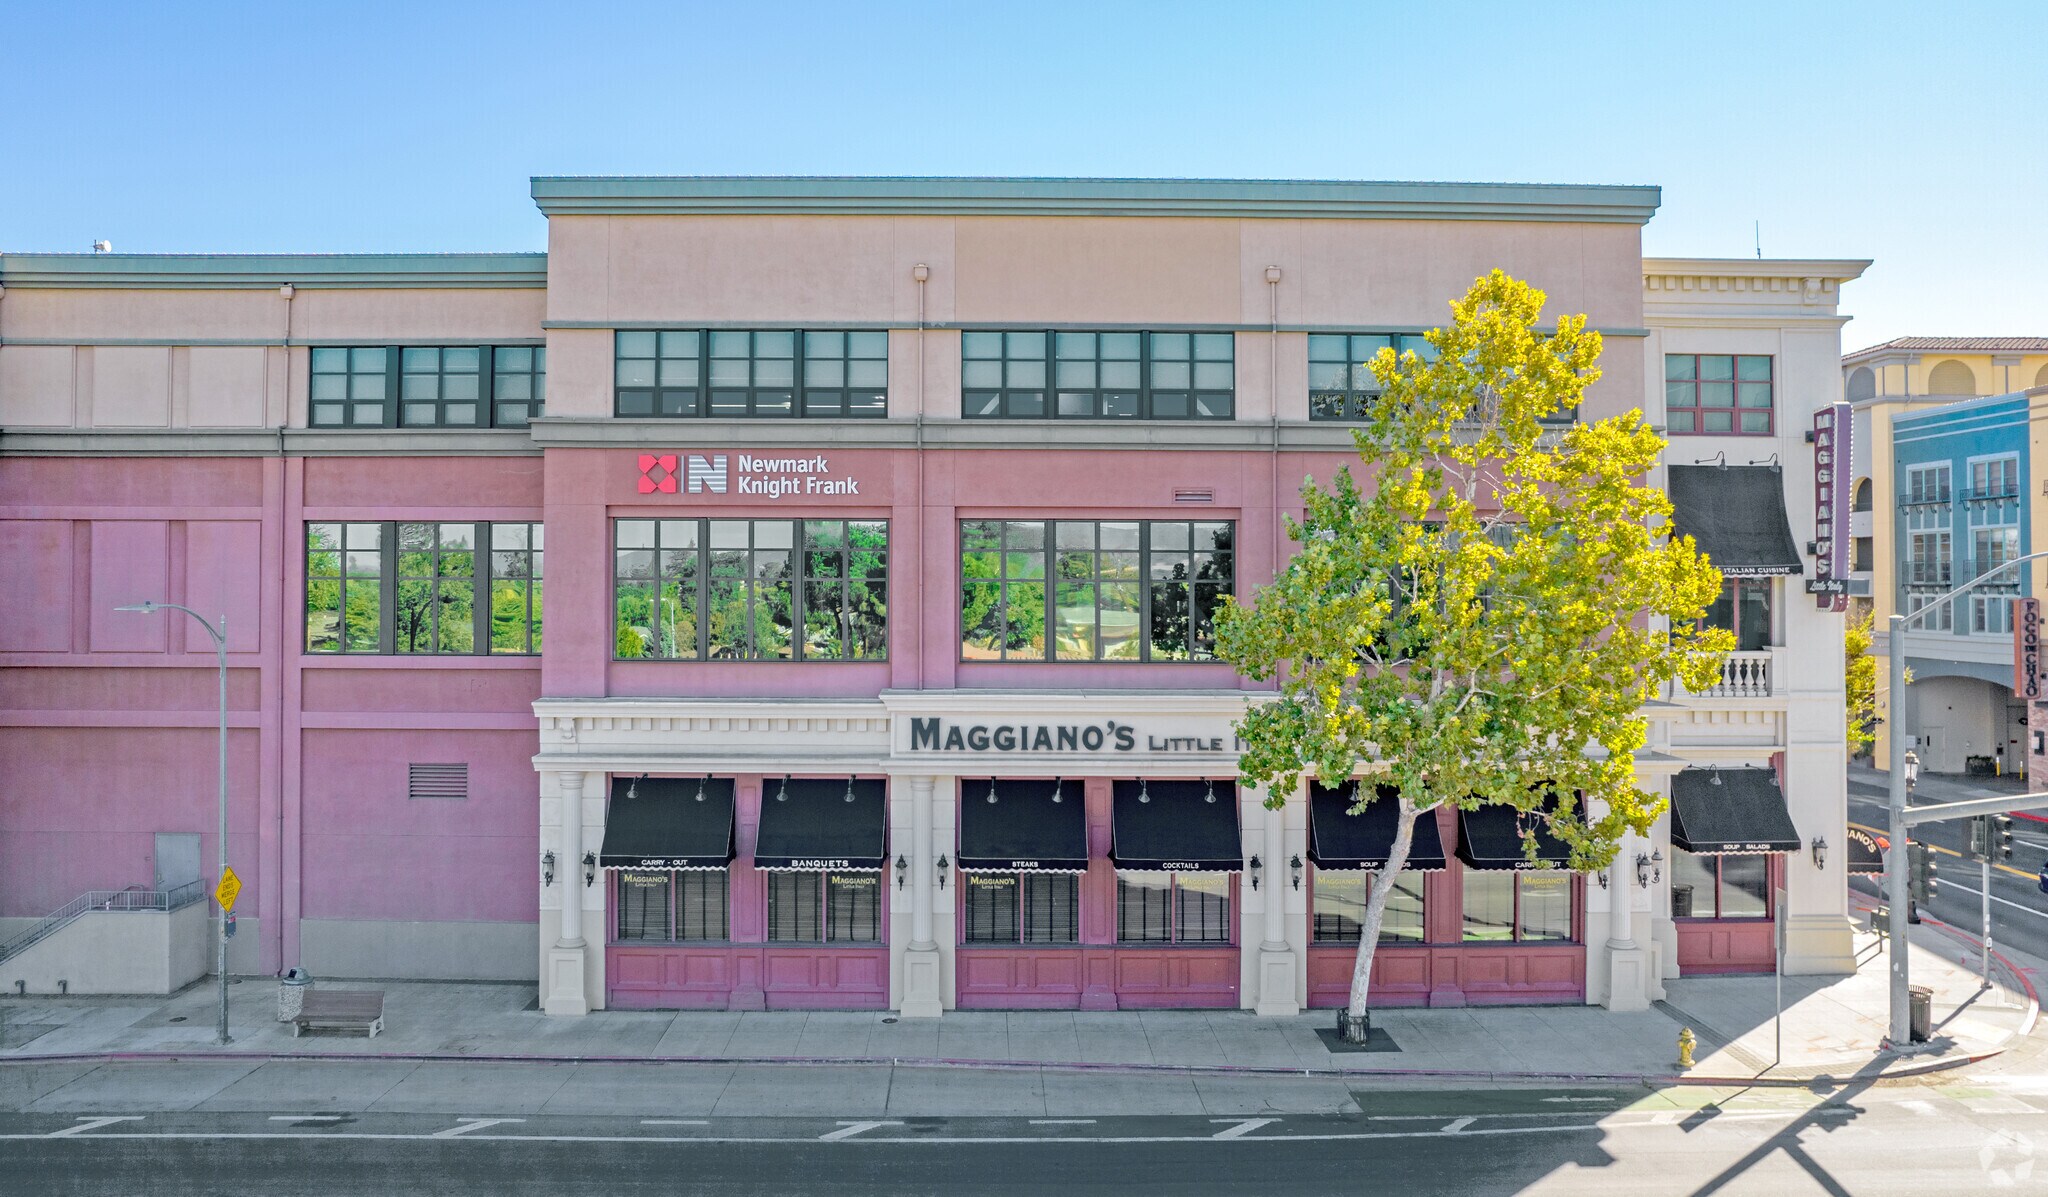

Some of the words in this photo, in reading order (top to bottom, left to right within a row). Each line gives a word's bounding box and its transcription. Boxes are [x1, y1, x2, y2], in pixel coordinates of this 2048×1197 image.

[738, 455, 829, 473] Newmark
[738, 476, 801, 499] Knight
[806, 476, 860, 495] Frank
[1816, 413, 1833, 575] MAGGIANO'S
[910, 717, 1136, 752] MAGGIANO'S
[1148, 735, 1223, 751] LITTLE
[791, 859, 849, 867] BANQUETS
[222, 875, 234, 884] LANE
[624, 874, 669, 883] MAGGIANO'S
[831, 876, 876, 884] MAGGIANO'S
[970, 876, 1015, 885] MAGGIANO'S
[1523, 876, 1568, 885] MAGGIANO'S
[222, 882, 234, 891] ENDS
[221, 889, 235, 898] MERGE
[223, 897, 234, 906] LEFT
